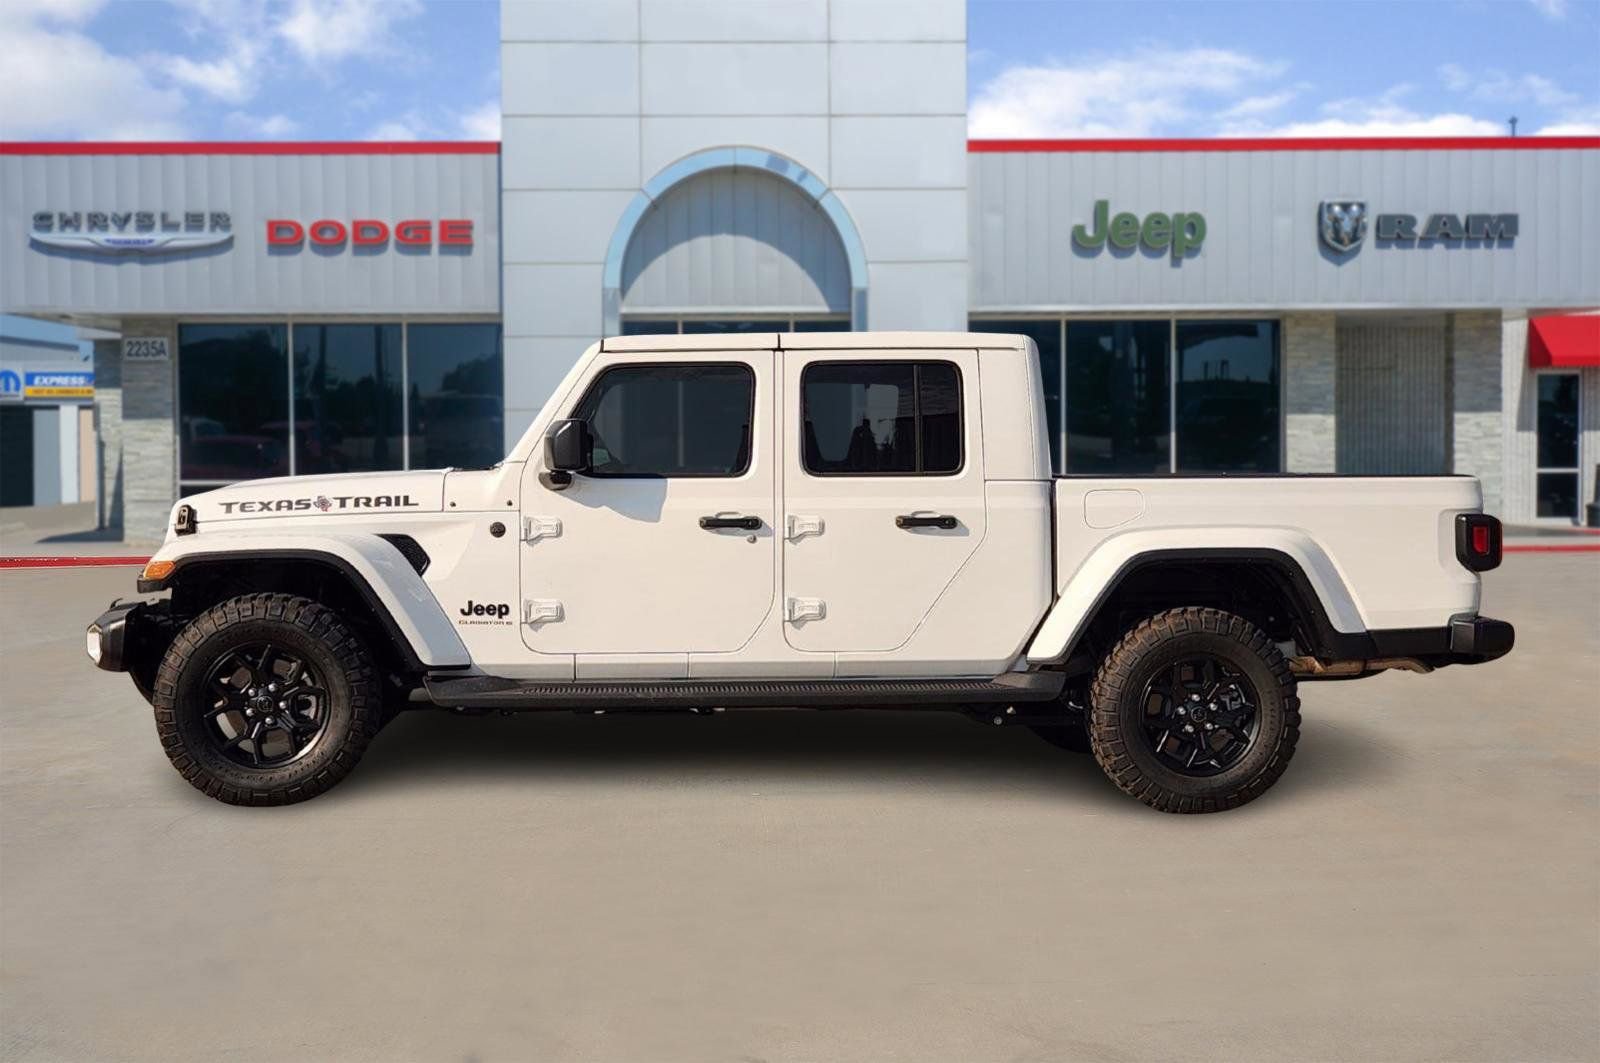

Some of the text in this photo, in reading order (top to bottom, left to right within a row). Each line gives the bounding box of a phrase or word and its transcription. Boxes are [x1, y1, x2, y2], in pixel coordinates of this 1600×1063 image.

[33, 211, 232, 231] CHRYSLER
[1072, 200, 1207, 258] Jeep
[1377, 213, 1519, 240] RAM
[266, 219, 474, 246] DODGE
[127, 338, 167, 358] 2235A
[33, 375, 86, 386] EXPRESS
[218, 495, 420, 514] TEXAS TRAIL
[460, 600, 510, 619] Jeep
